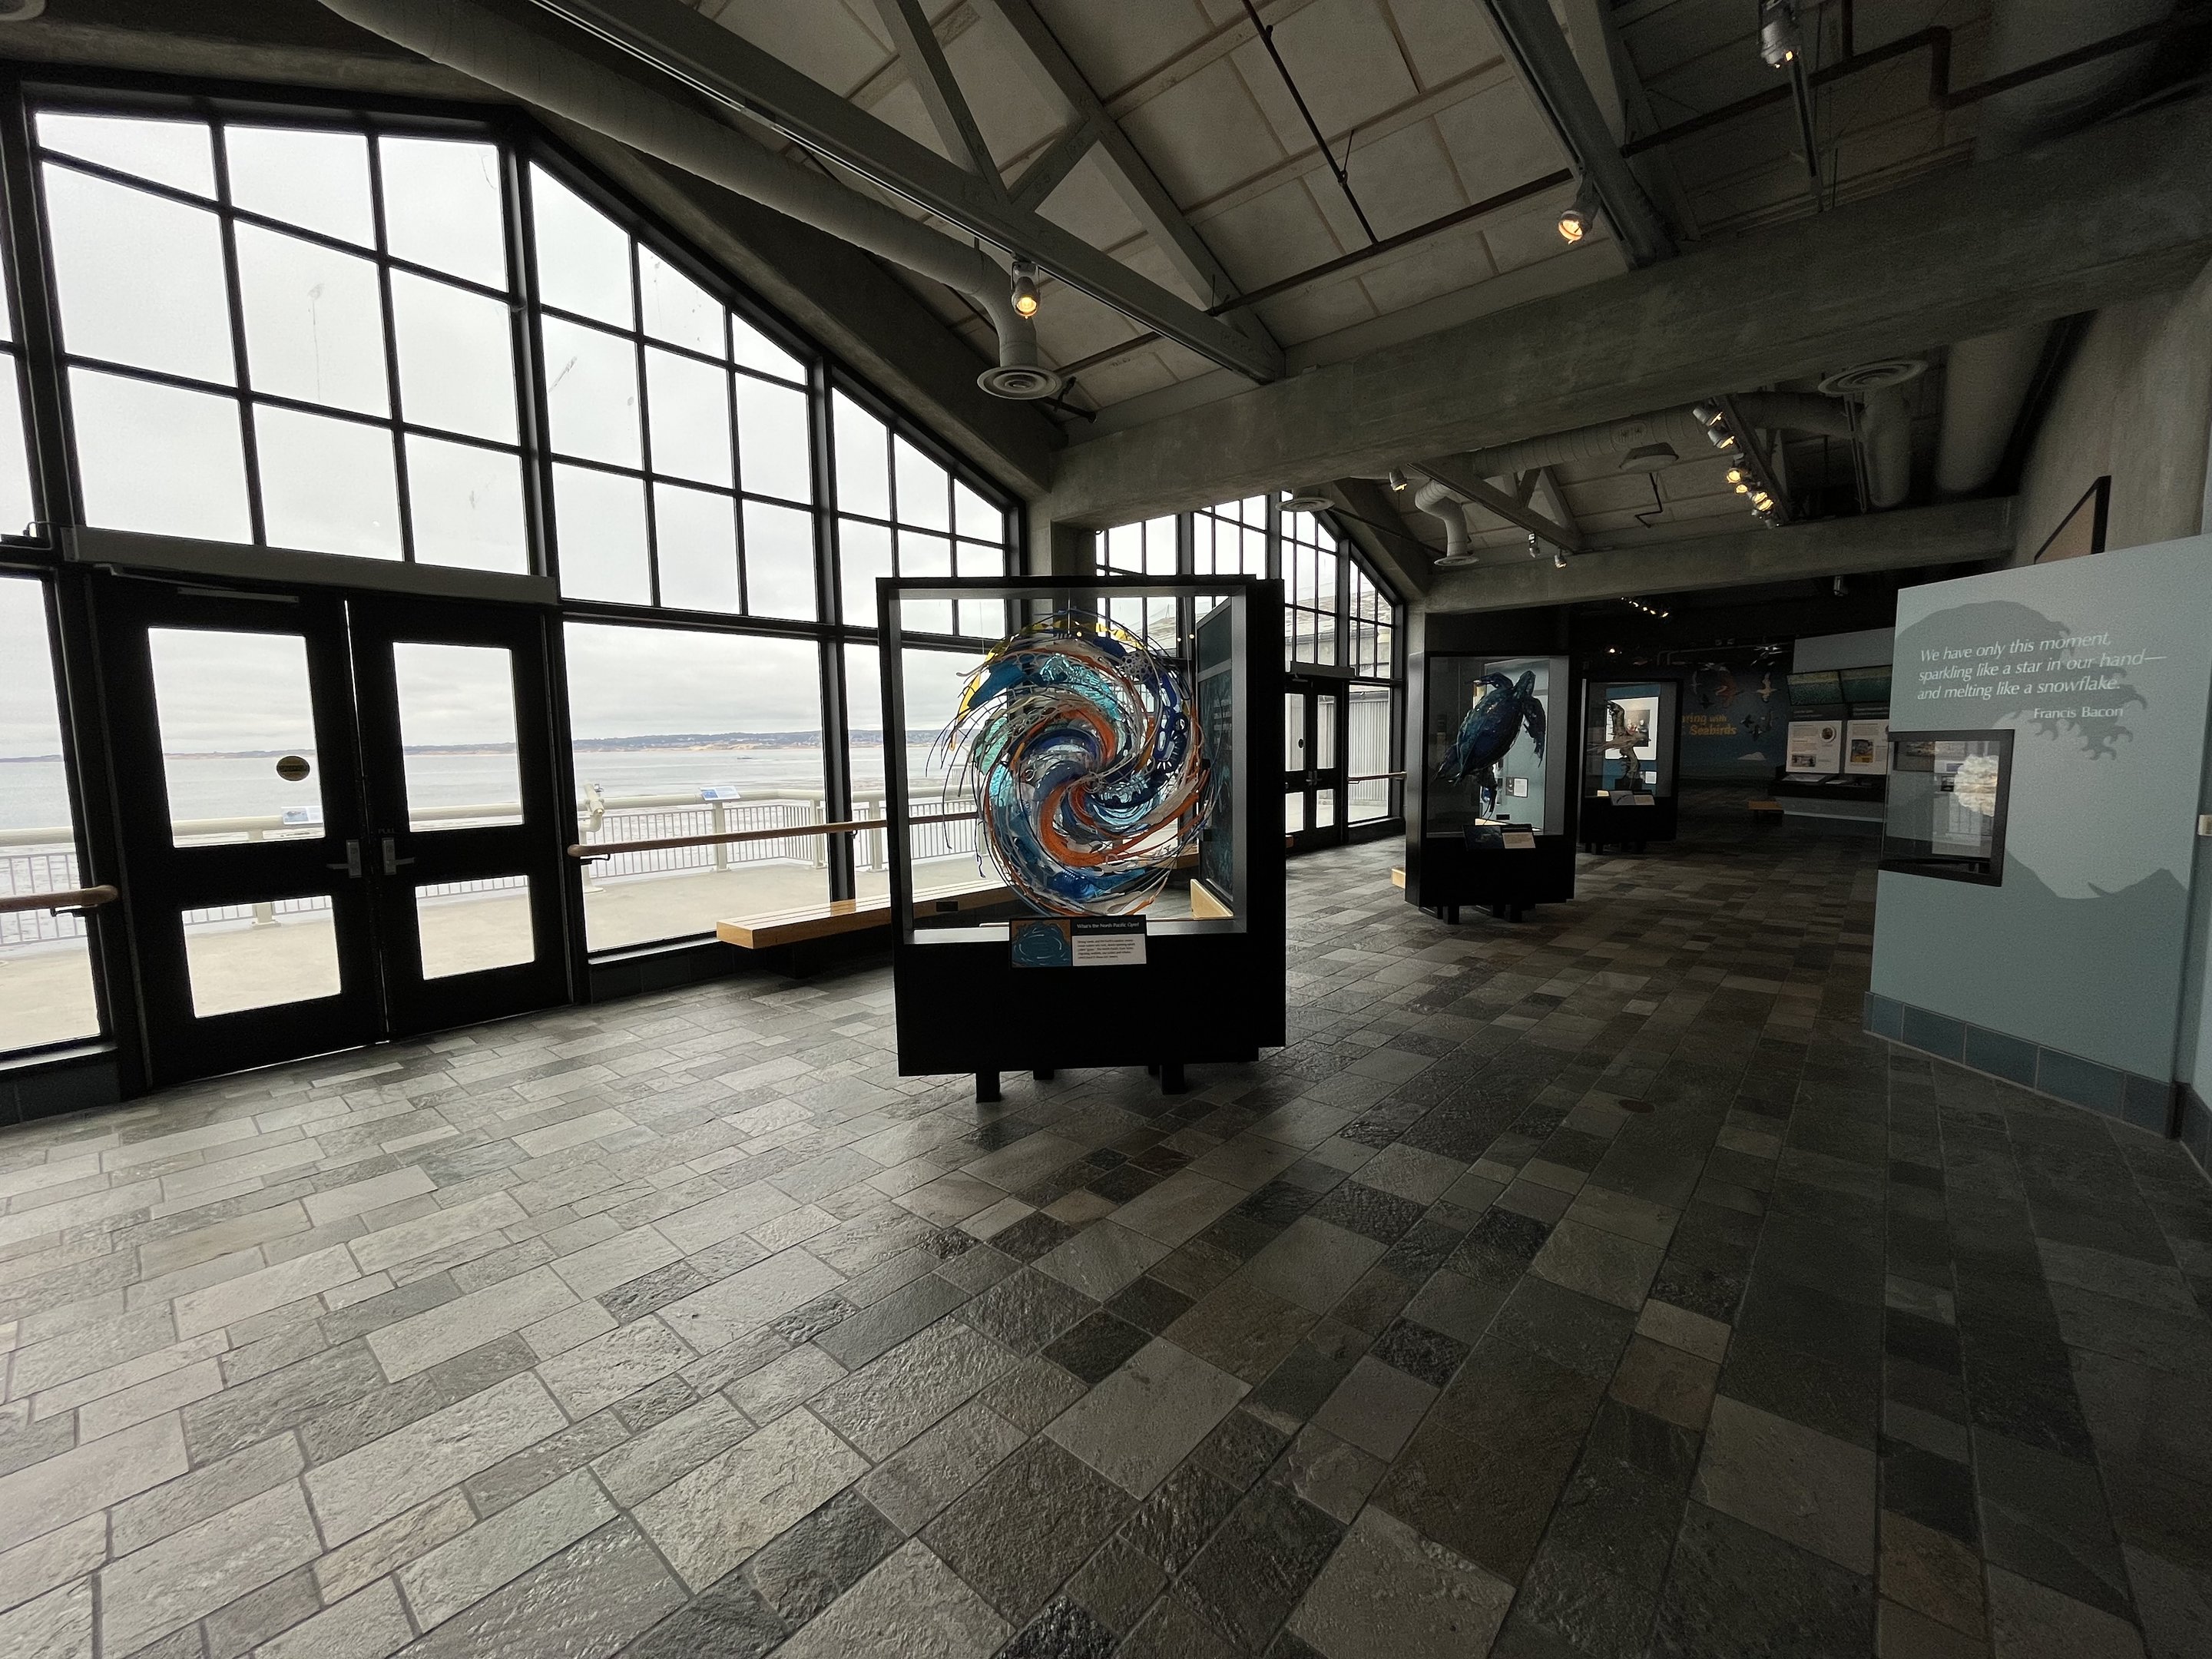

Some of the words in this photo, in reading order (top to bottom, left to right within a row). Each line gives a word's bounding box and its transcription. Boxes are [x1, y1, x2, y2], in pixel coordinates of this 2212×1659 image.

[1921, 650, 1939, 662] We
[1943, 647, 1972, 661] have
[1976, 641, 2005, 659] only
[2009, 639, 2034, 654] this
[2039, 632, 2111, 651] moment,
[1918, 664, 1972, 684] sparkling
[1976, 662, 1999, 677] like
[2002, 665, 2012, 675] a
[2015, 660, 2041, 674] star
[2047, 657, 2061, 672] in
[2066, 657, 2094, 671] our
[1918, 686, 1941, 700] and
[1944, 683, 1992, 700] melting
[1996, 681, 2020, 696] like
[2023, 684, 2032, 695] a
[2037, 675, 2121, 694] snowflake.
[2033, 706, 2077, 720] Francis
[2081, 705, 2124, 718] Bacon
[1690, 724, 1737, 735] Seabirds
